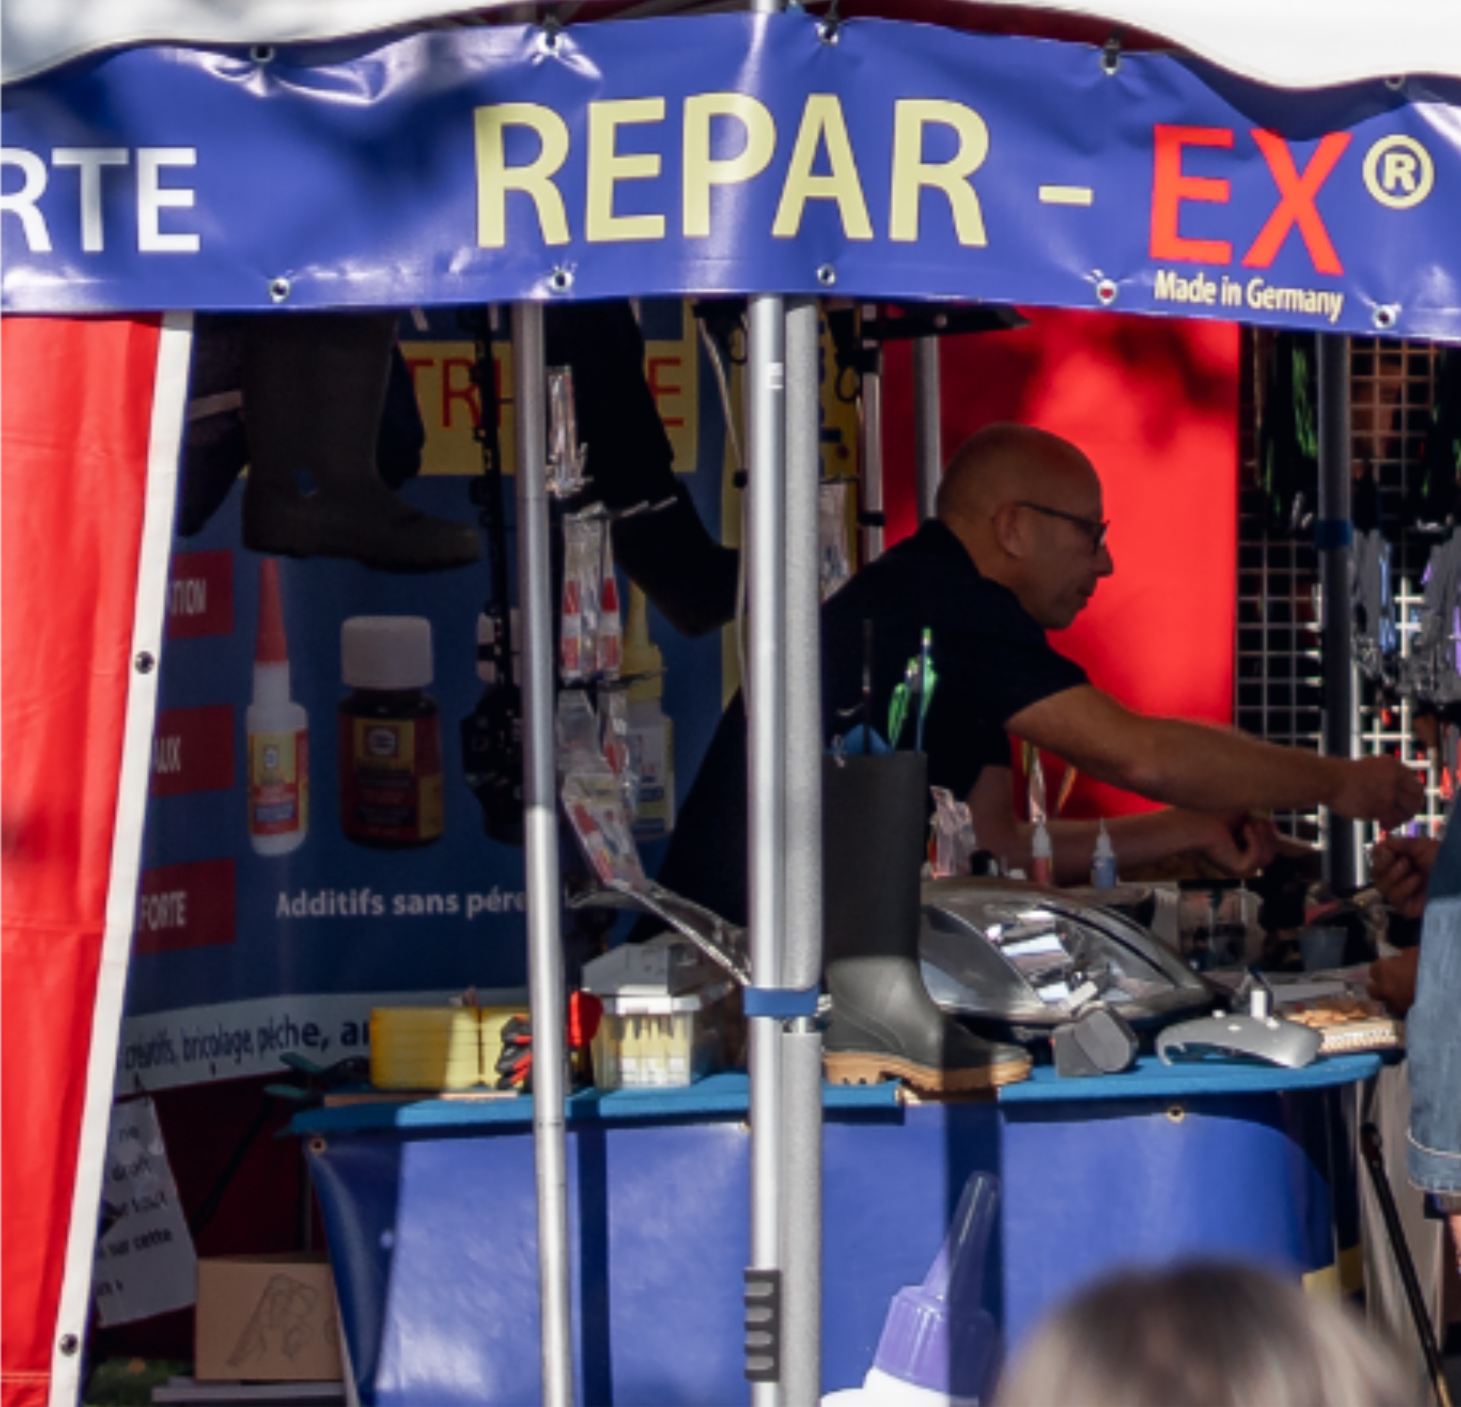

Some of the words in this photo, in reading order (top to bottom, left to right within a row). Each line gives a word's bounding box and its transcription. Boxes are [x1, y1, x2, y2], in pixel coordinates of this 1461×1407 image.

[472, 91, 991, 250] REPAR
[1153, 267, 1216, 306] Made
[1220, 271, 1242, 307] in
[1246, 275, 1345, 324] Germany
[275, 886, 386, 920] Additifs
[390, 890, 461, 917] sans
